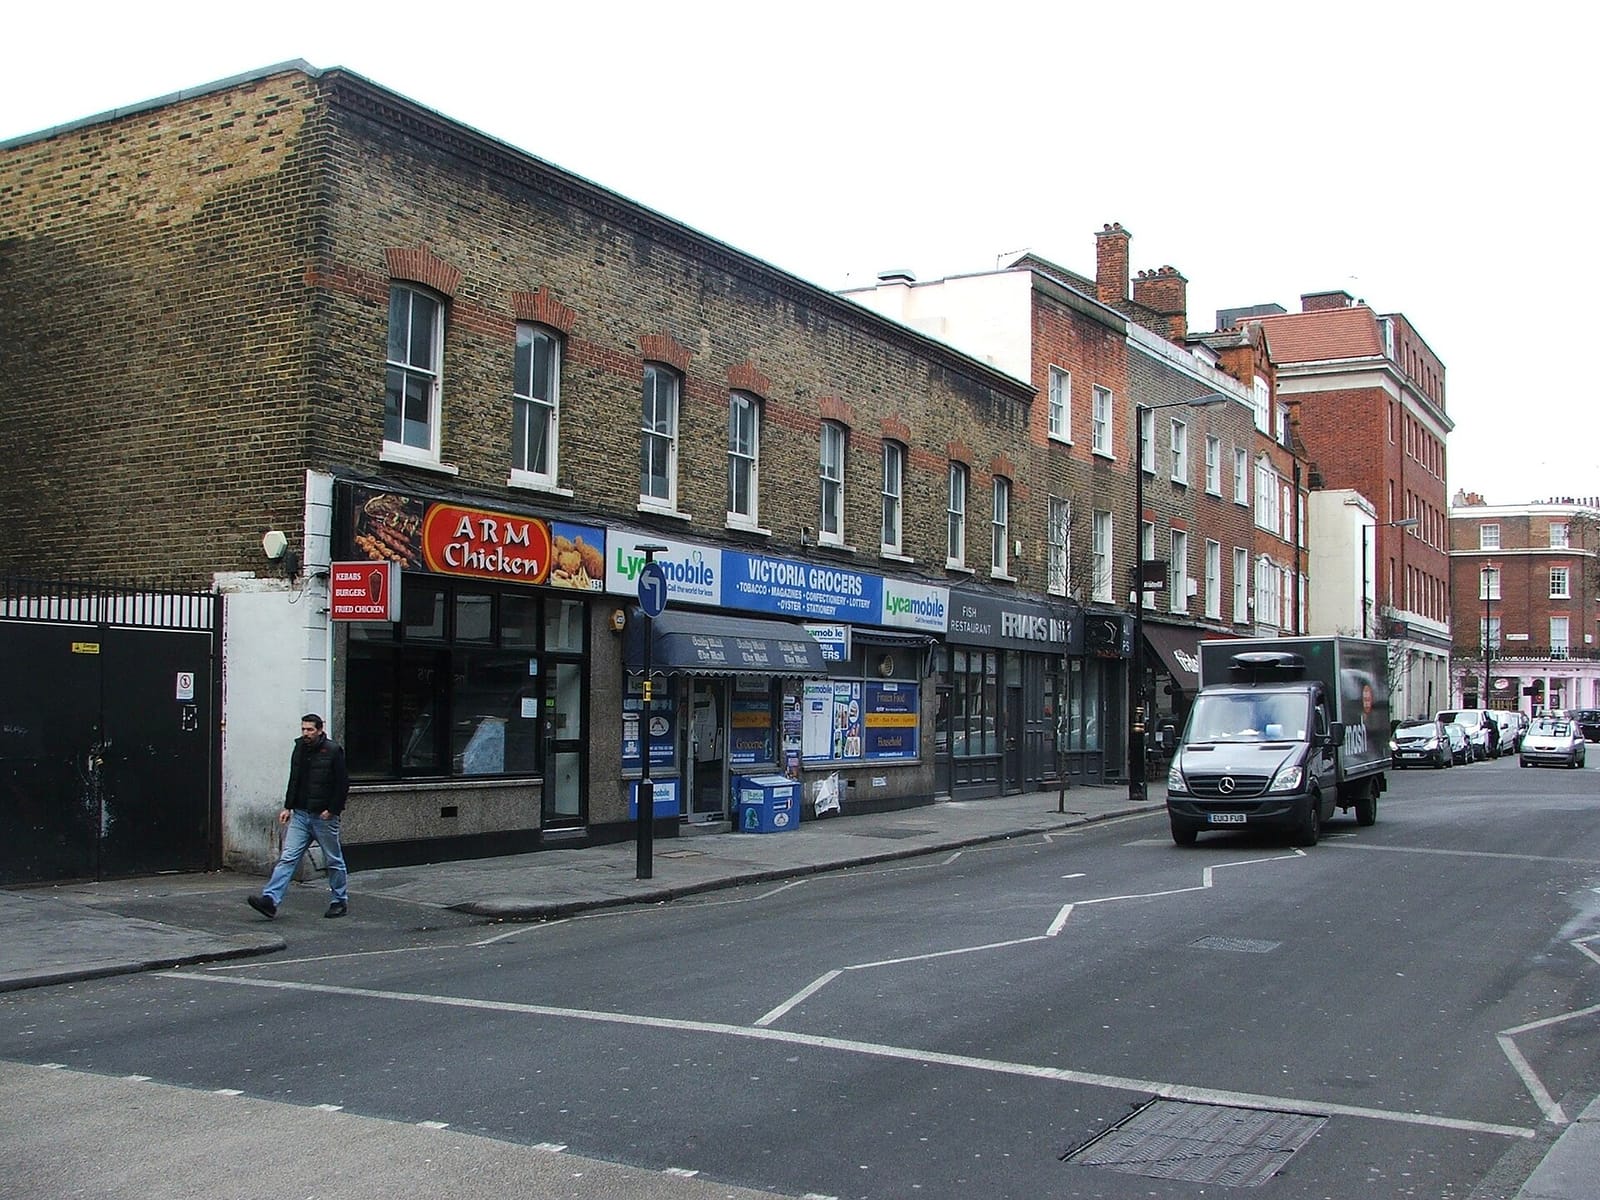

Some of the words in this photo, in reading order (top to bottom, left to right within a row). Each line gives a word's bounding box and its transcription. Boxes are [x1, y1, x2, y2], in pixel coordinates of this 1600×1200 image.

[453, 515, 530, 547] ARM
[443, 541, 538, 576] Chicken
[617, 547, 713, 586] Lycmobile
[335, 572, 362, 581] KEBABS
[748, 558, 806, 588] VICTORIA
[809, 568, 863, 596] GROCERS
[335, 588, 366, 597] BURGERS
[739, 581, 768, 595] TOBACCO
[771, 586, 802, 600] MAGAZINES
[805, 591, 846, 606] CONFECTIONERY
[849, 598, 871, 609] LOTTERY
[780, 600, 801, 611] OYSTER
[886, 590, 944, 618] Lycamobile
[355, 605, 384, 614] CHICKEN
[962, 605, 977, 618] FISH
[950, 619, 992, 636] RESTAURANT
[1001, 611, 1047, 642] FRIARS
